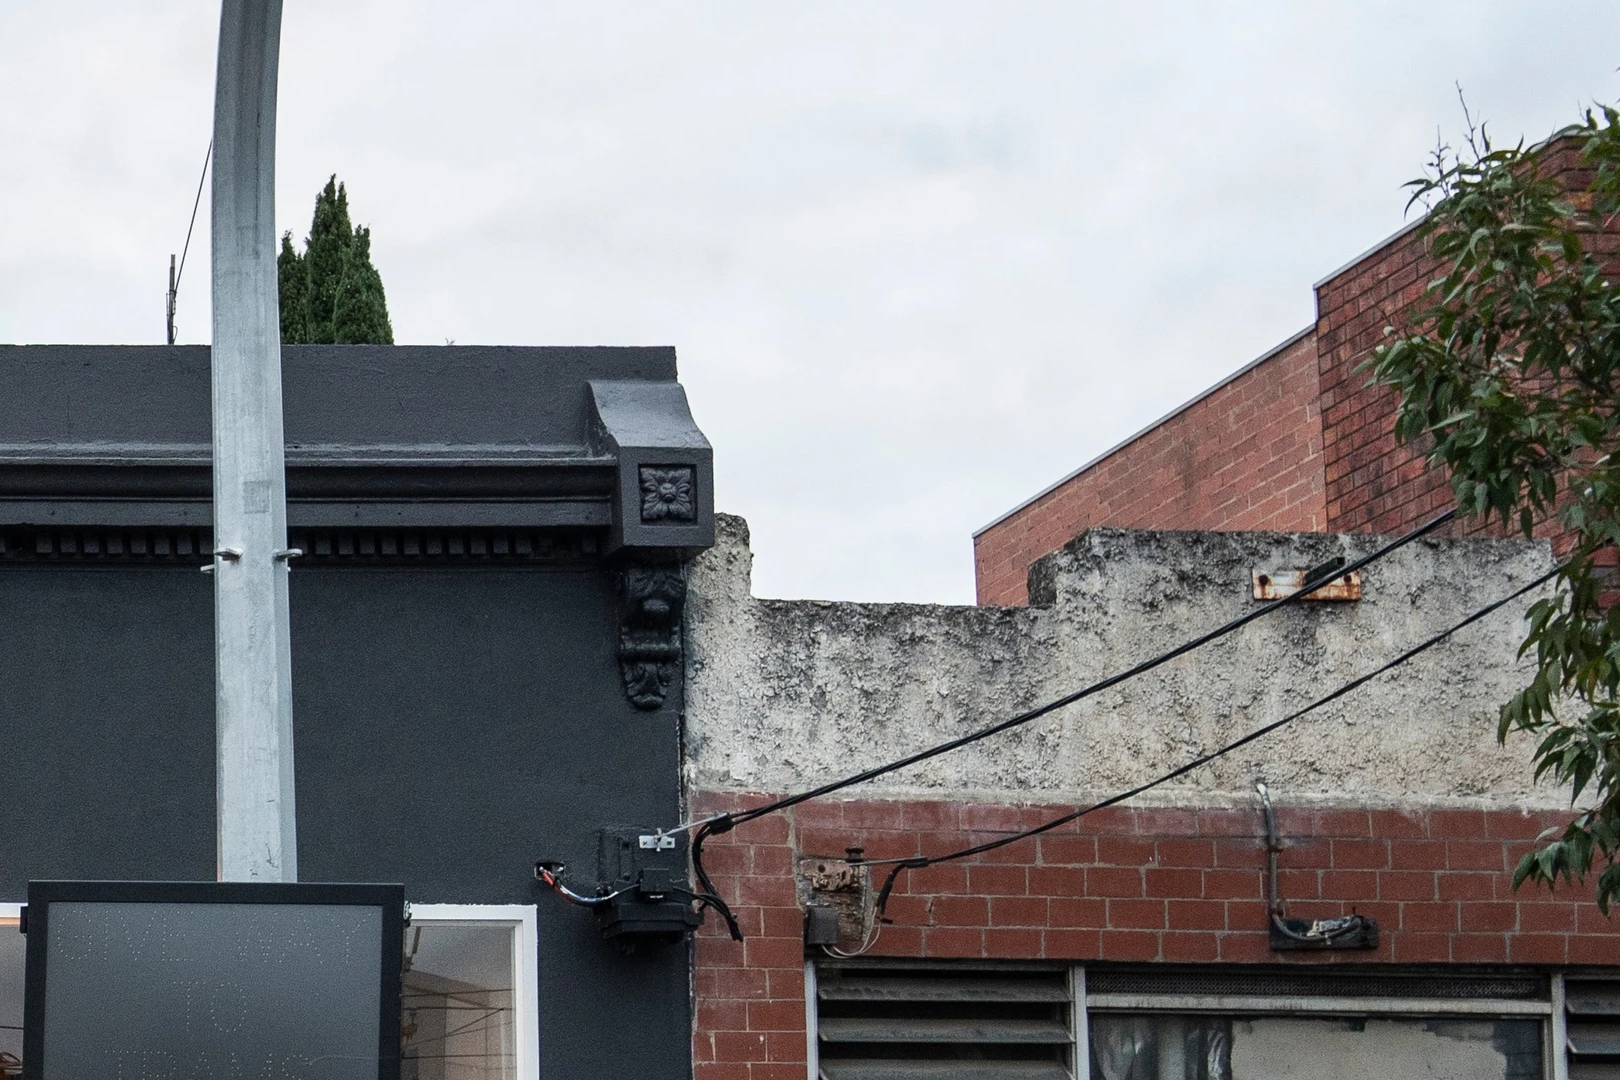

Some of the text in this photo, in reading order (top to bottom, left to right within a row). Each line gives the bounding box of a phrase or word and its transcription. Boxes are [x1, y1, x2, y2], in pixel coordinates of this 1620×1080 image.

[57, 909, 372, 964] GIVE WAY
[173, 980, 247, 1033] TO
